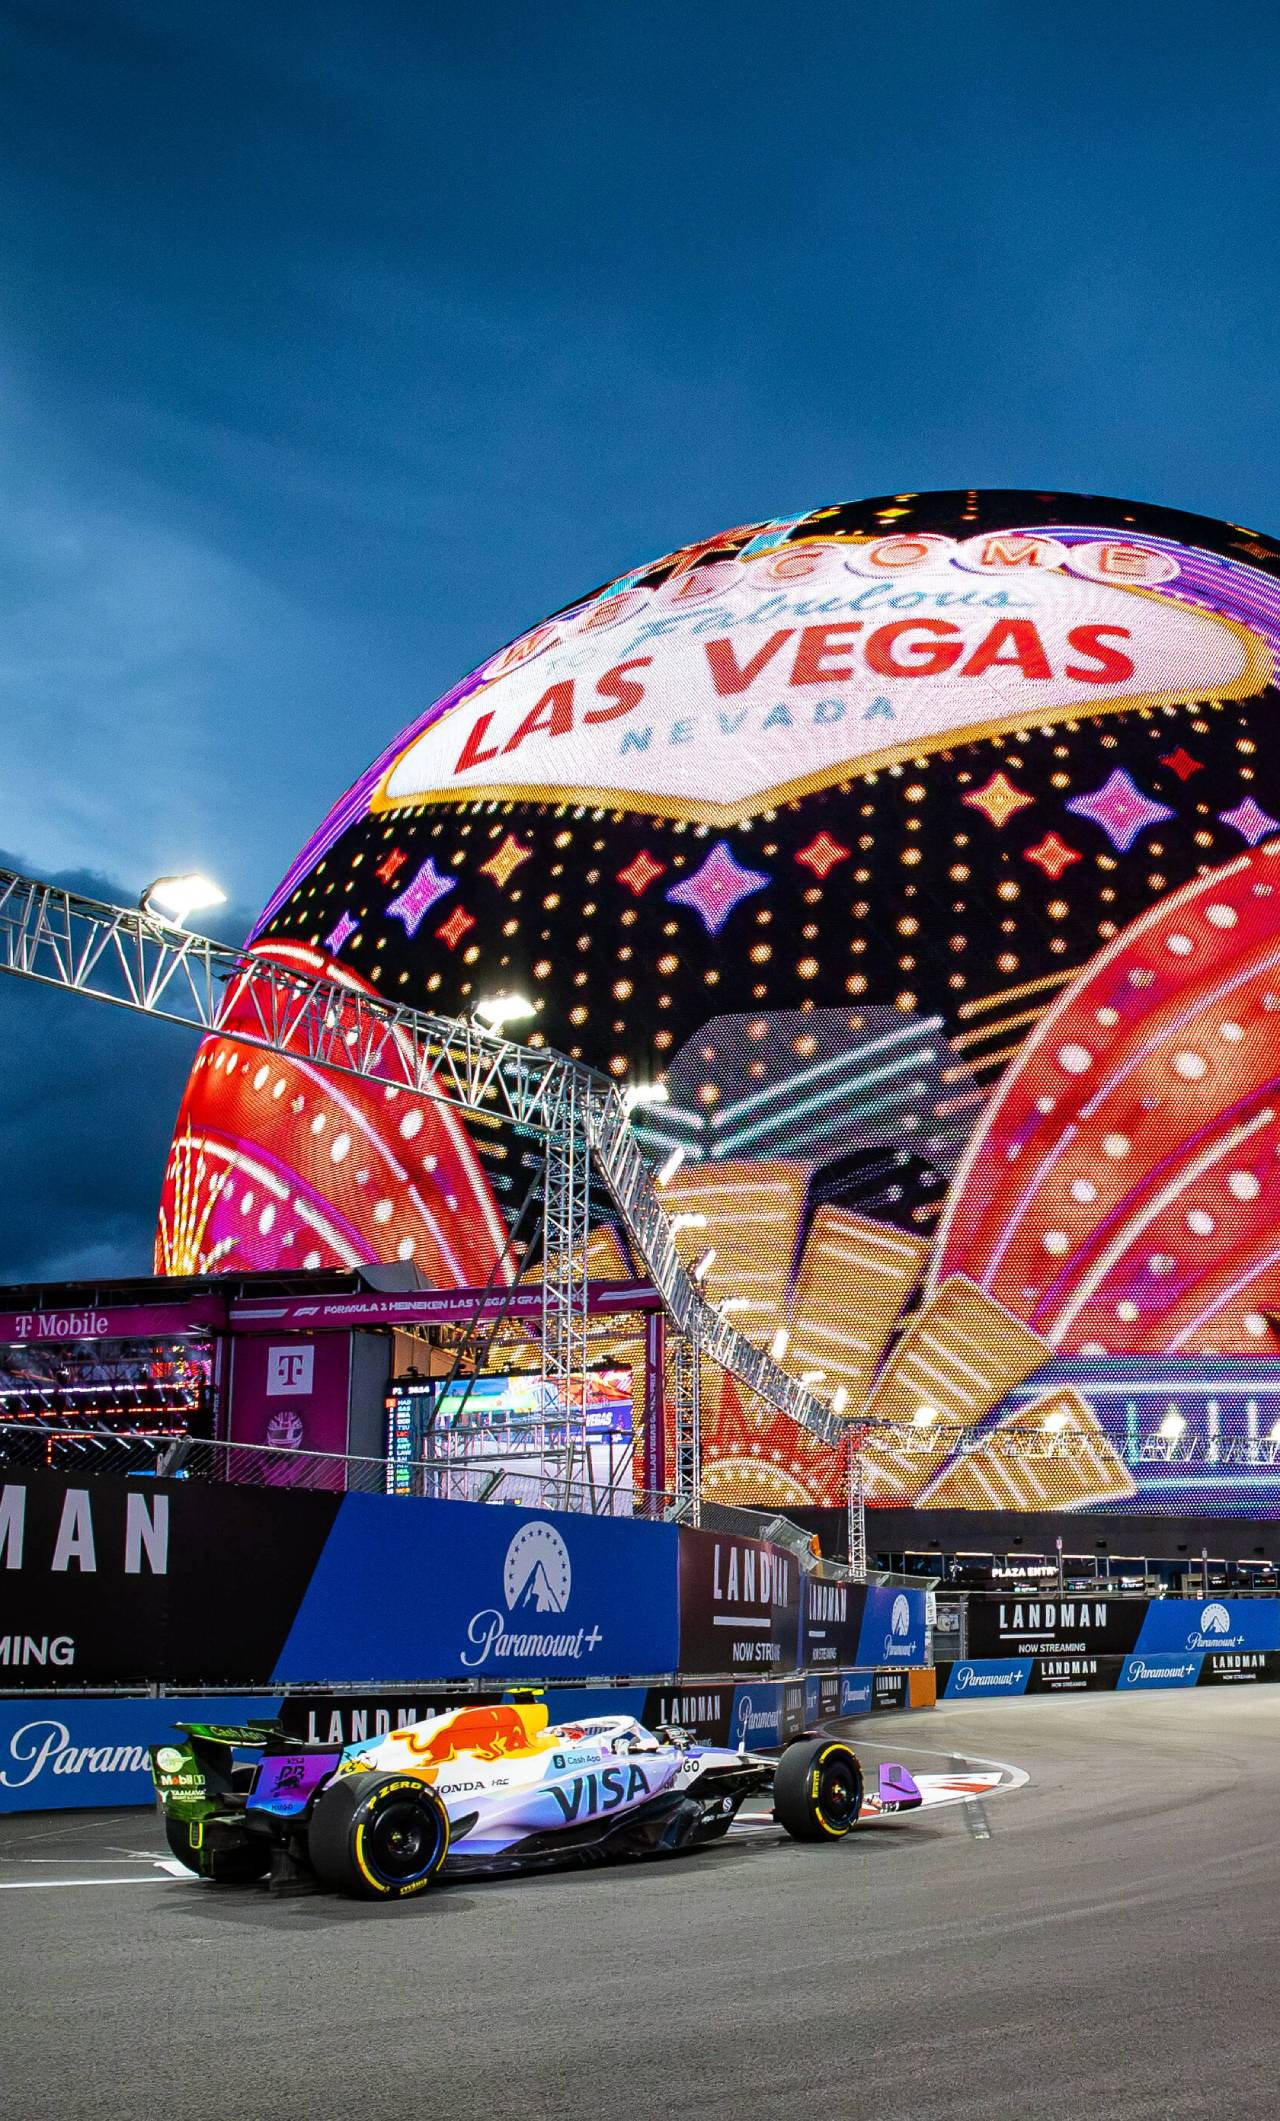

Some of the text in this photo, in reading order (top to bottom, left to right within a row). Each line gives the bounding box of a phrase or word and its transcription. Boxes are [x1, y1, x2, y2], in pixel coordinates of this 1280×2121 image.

[453, 616, 1136, 776] LAS VEGAS
[618, 696, 896, 756] NEVADA
[323, 1304, 379, 1315] FORMULA
[389, 1300, 449, 1311] HEINEKEN
[450, 1299, 473, 1309] LAS
[38, 1312, 109, 1337] Mobile
[278, 1354, 304, 1386] T
[991, 1567, 1026, 1578] PLAZA
[1000, 1604, 1107, 1629] LANDMAN
[460, 1609, 604, 1667] Paramount+
[1018, 1642, 1086, 1653] NOW STREAMING
[1185, 1631, 1246, 1652] Paramount+
[732, 1642, 754, 1661] NOW
[1212, 1654, 1266, 1669] LANDMAN
[954, 1666, 1024, 1691] Paramount+
[1041, 1660, 1097, 1675] LANDMAN
[1127, 1660, 1196, 1683] Paramount+
[660, 1695, 721, 1724] LANDMAN
[308, 1706, 459, 1744] LANDM
[567, 1755, 586, 1765] Cash
[676, 1760, 700, 1773] GO
[160, 1774, 193, 1786] Mobil
[378, 1780, 423, 1799] ZERO
[539, 1763, 650, 1823] VISA
